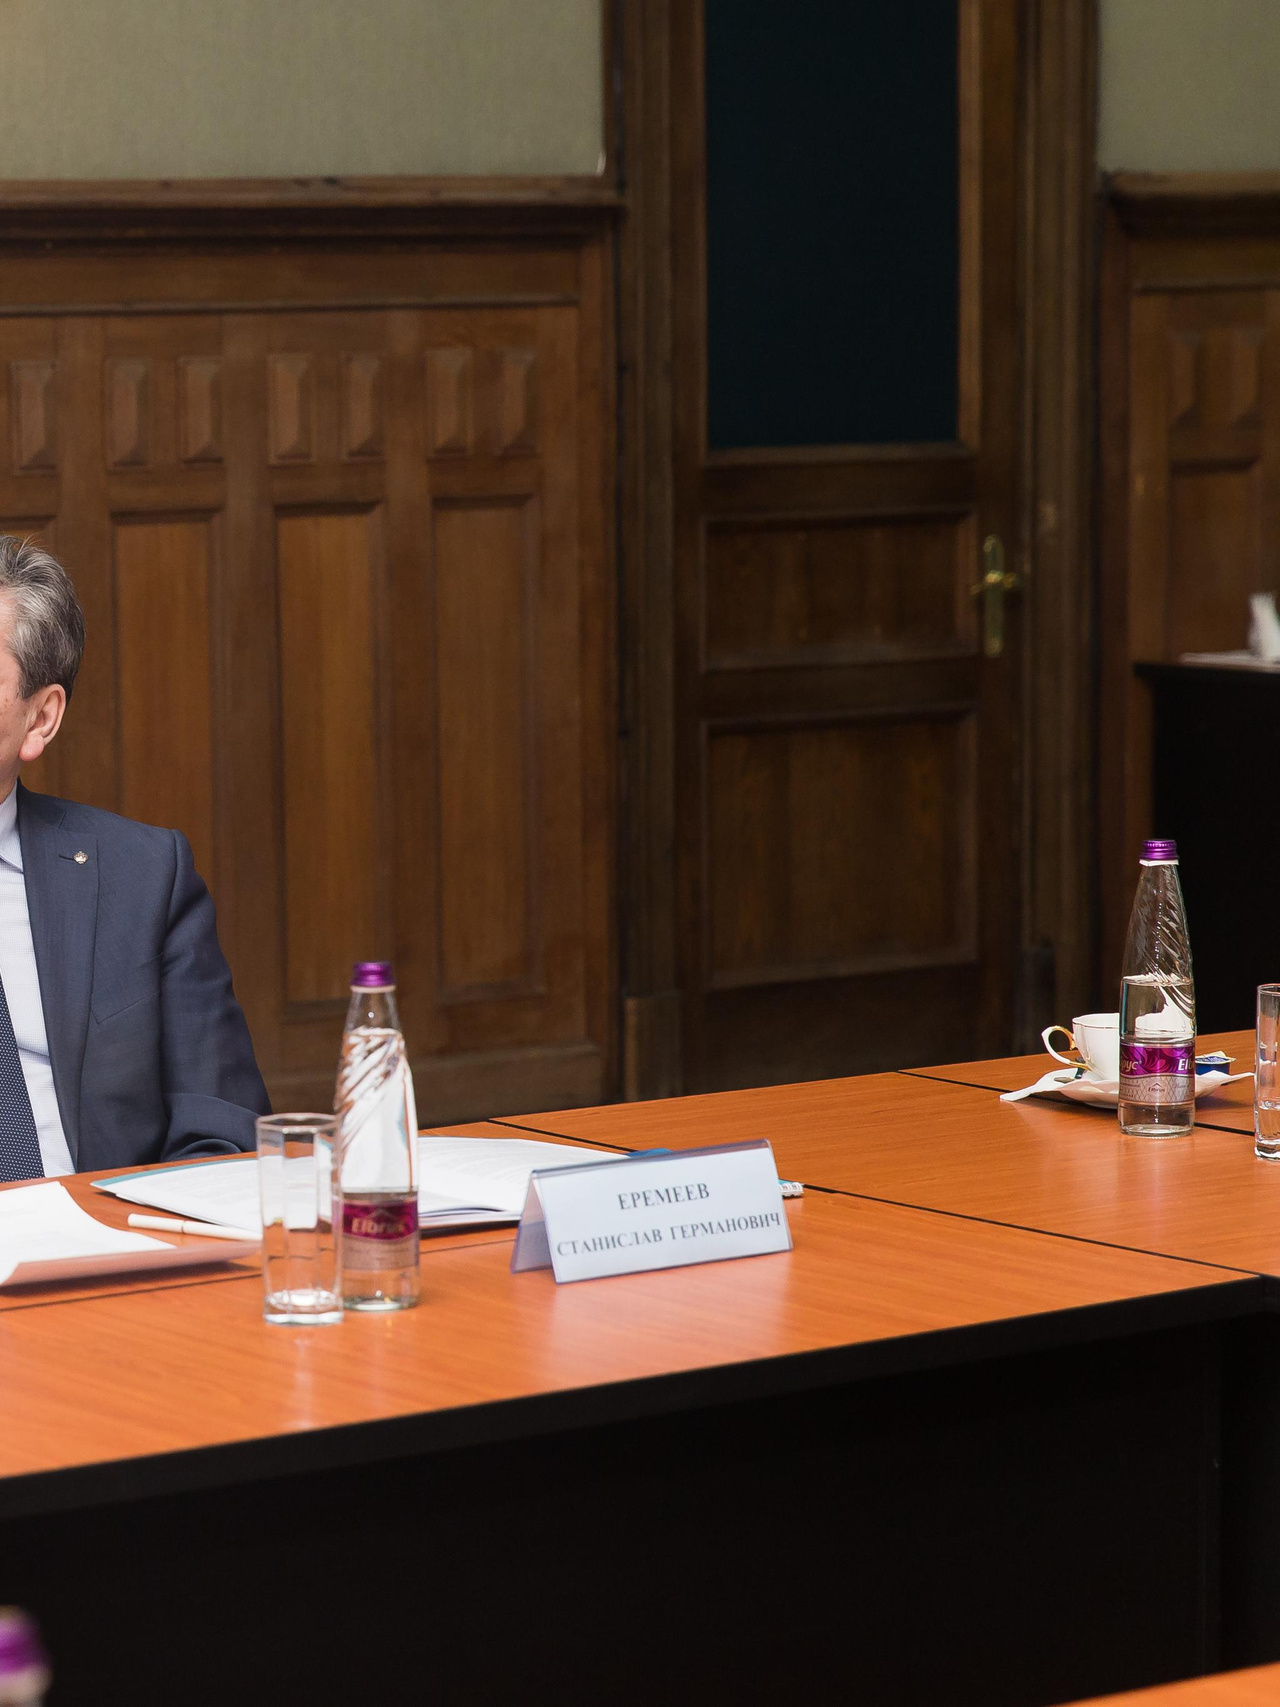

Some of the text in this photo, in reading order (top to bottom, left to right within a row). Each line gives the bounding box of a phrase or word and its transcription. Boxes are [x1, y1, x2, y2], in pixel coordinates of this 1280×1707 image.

[617, 1183, 710, 1210] ЕРЕМЕЕВ
[557, 1212, 781, 1256] СТАНИСЛАВ ГЕРМАНОВИЧ
